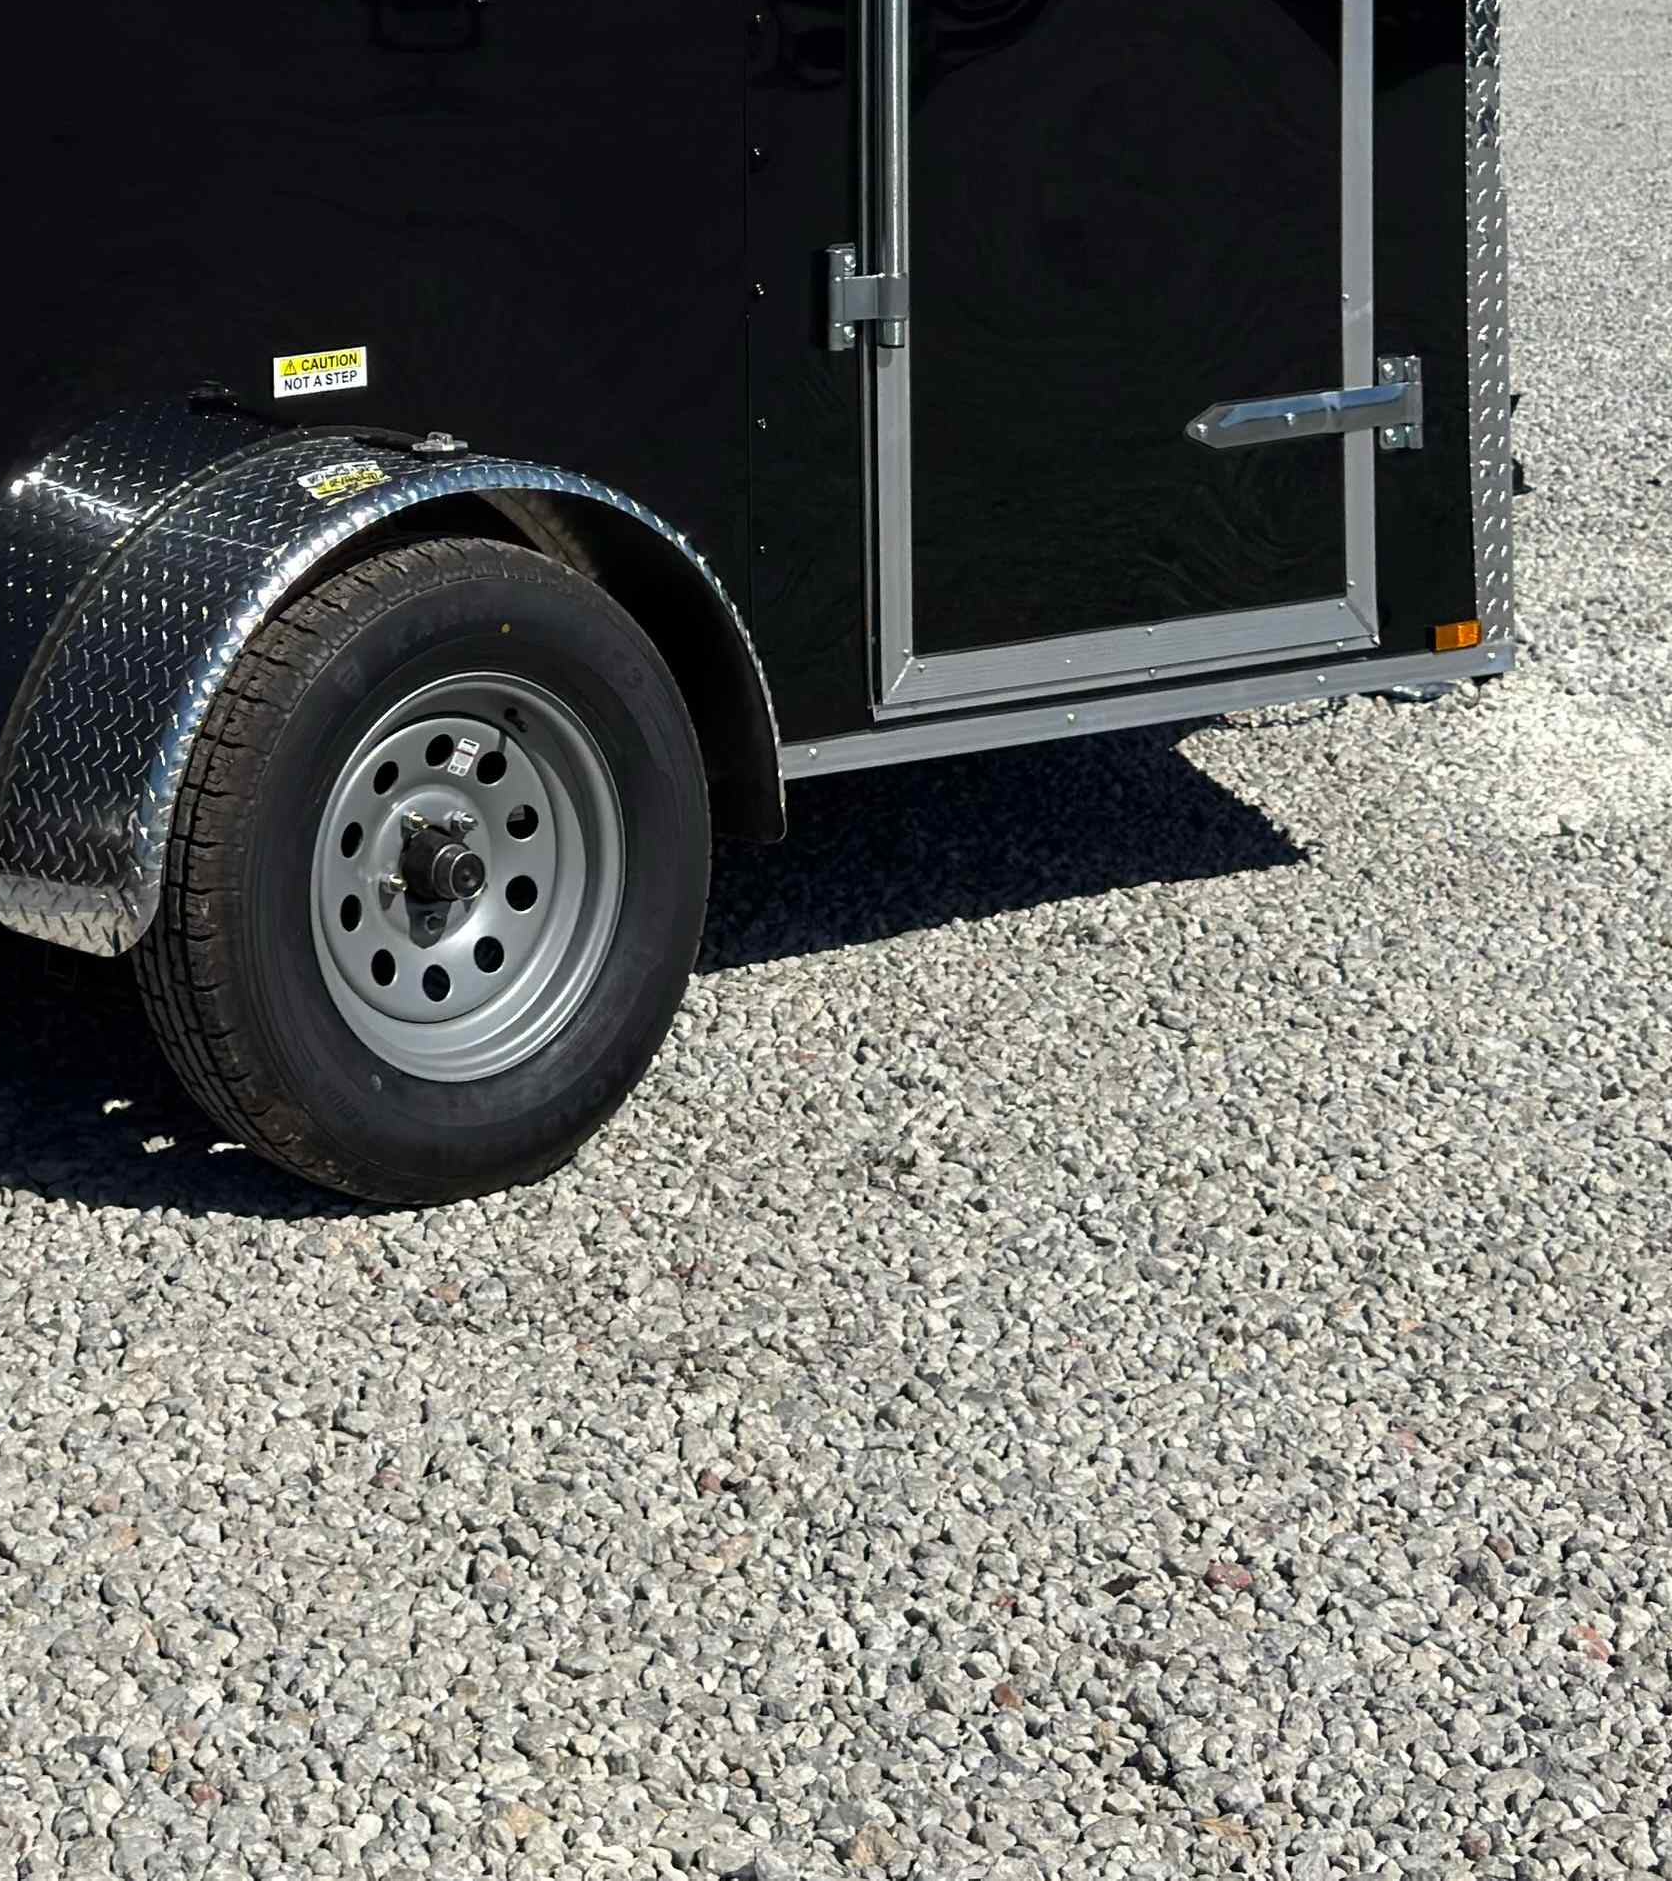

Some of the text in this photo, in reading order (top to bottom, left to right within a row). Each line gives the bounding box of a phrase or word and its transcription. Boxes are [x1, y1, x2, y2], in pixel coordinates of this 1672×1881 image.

[301, 352, 358, 372] CAUTION
[284, 369, 358, 391] NOT A STEP
